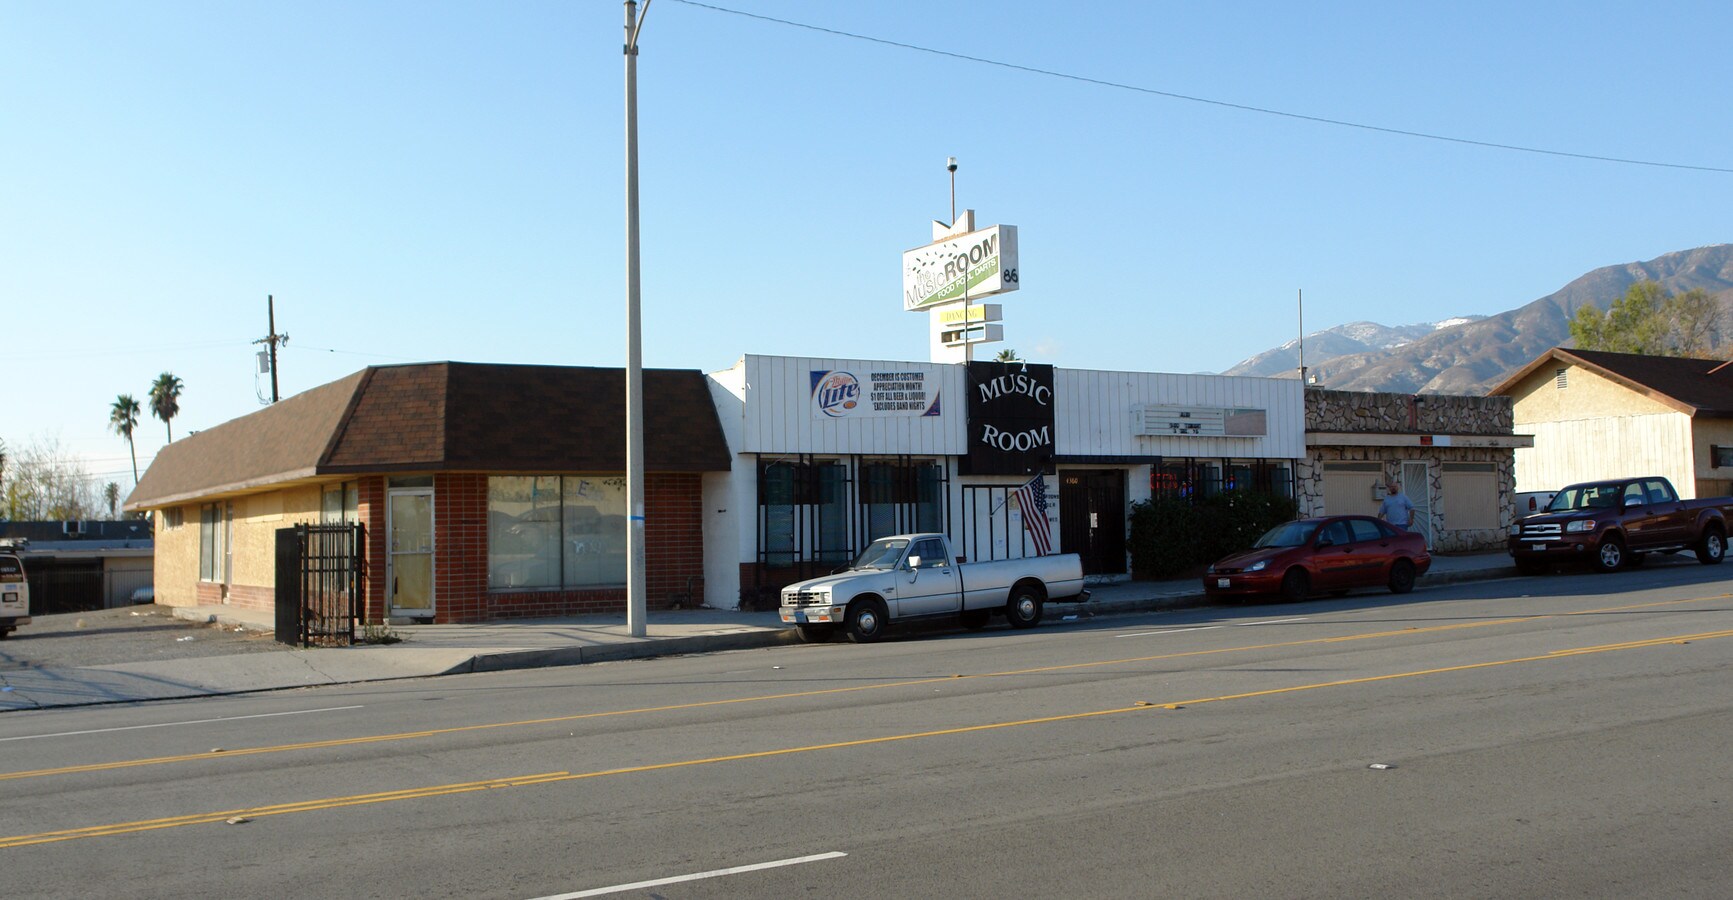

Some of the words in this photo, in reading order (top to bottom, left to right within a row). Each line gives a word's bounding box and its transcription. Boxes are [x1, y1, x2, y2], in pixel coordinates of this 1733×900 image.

[906, 272, 946, 308] Music
[944, 233, 998, 282] ROOM
[1003, 268, 1018, 283] 86
[937, 285, 955, 299] FOOD
[974, 258, 997, 276] DARTS
[946, 308, 978, 322] DANCNG
[871, 373, 895, 382] DECEMBER
[895, 373, 900, 382] IS
[901, 373, 924, 382] CUSTOMER
[874, 382, 905, 391] APPRECIATION
[978, 374, 1051, 406] MUSIC
[871, 392, 876, 401] $1
[877, 392, 885, 401] OFF
[885, 392, 893, 401] ALL
[894, 392, 905, 401] BEER
[897, 401, 909, 410] BAND
[909, 401, 925, 410] NIGHTS
[982, 424, 1051, 451] ROOM
